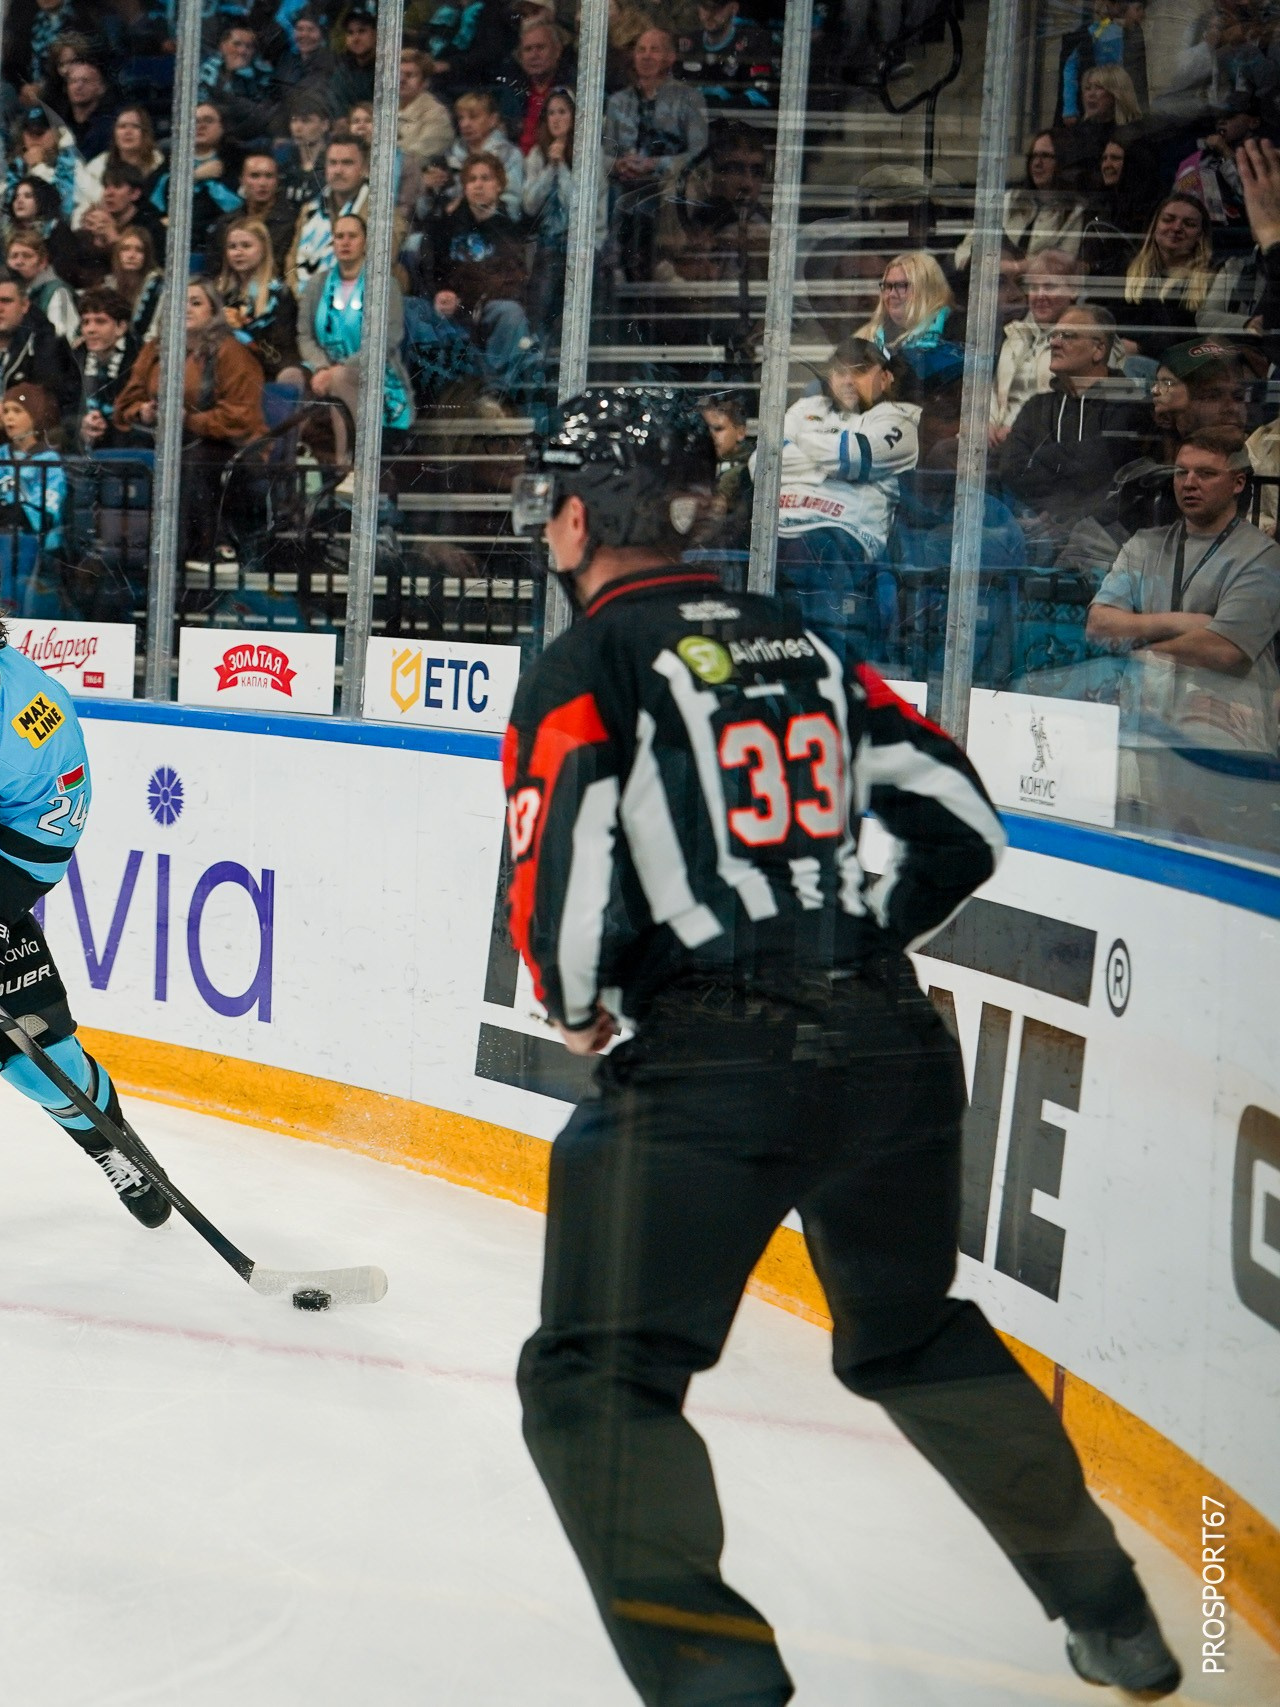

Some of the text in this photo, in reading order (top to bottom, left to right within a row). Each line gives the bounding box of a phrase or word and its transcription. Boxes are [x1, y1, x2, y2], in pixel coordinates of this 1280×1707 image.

[727, 636, 816, 666] Airlines
[18, 696, 51, 731] MAX
[32, 710, 63, 741] LINE
[718, 711, 845, 847] 33
[1020, 774, 1057, 799] КОНУС
[37, 790, 89, 837] 24
[4, 937, 40, 962] avia
